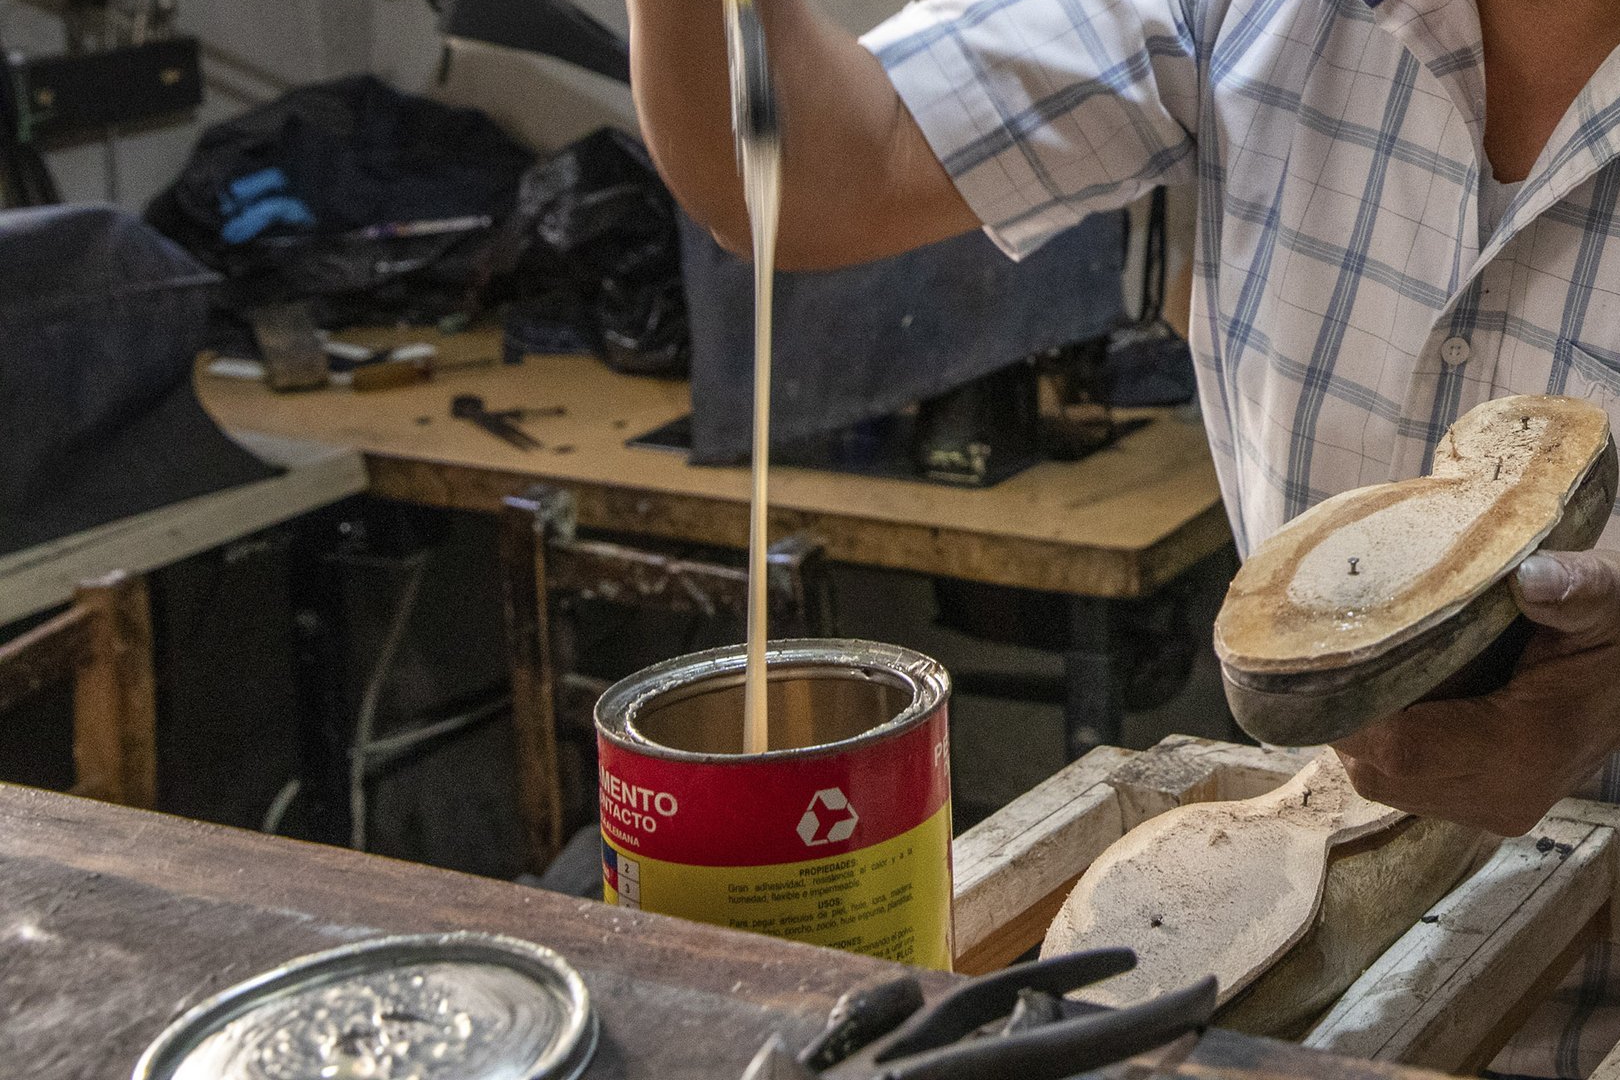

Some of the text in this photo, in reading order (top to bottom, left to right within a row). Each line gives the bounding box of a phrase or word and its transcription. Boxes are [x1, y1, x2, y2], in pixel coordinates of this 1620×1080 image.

[600, 765, 679, 816] MENTO
[600, 788, 657, 833] NTACTO
[624, 863, 630, 874] 2
[728, 883, 749, 893] Gran
[818, 898, 843, 909] USOS:
